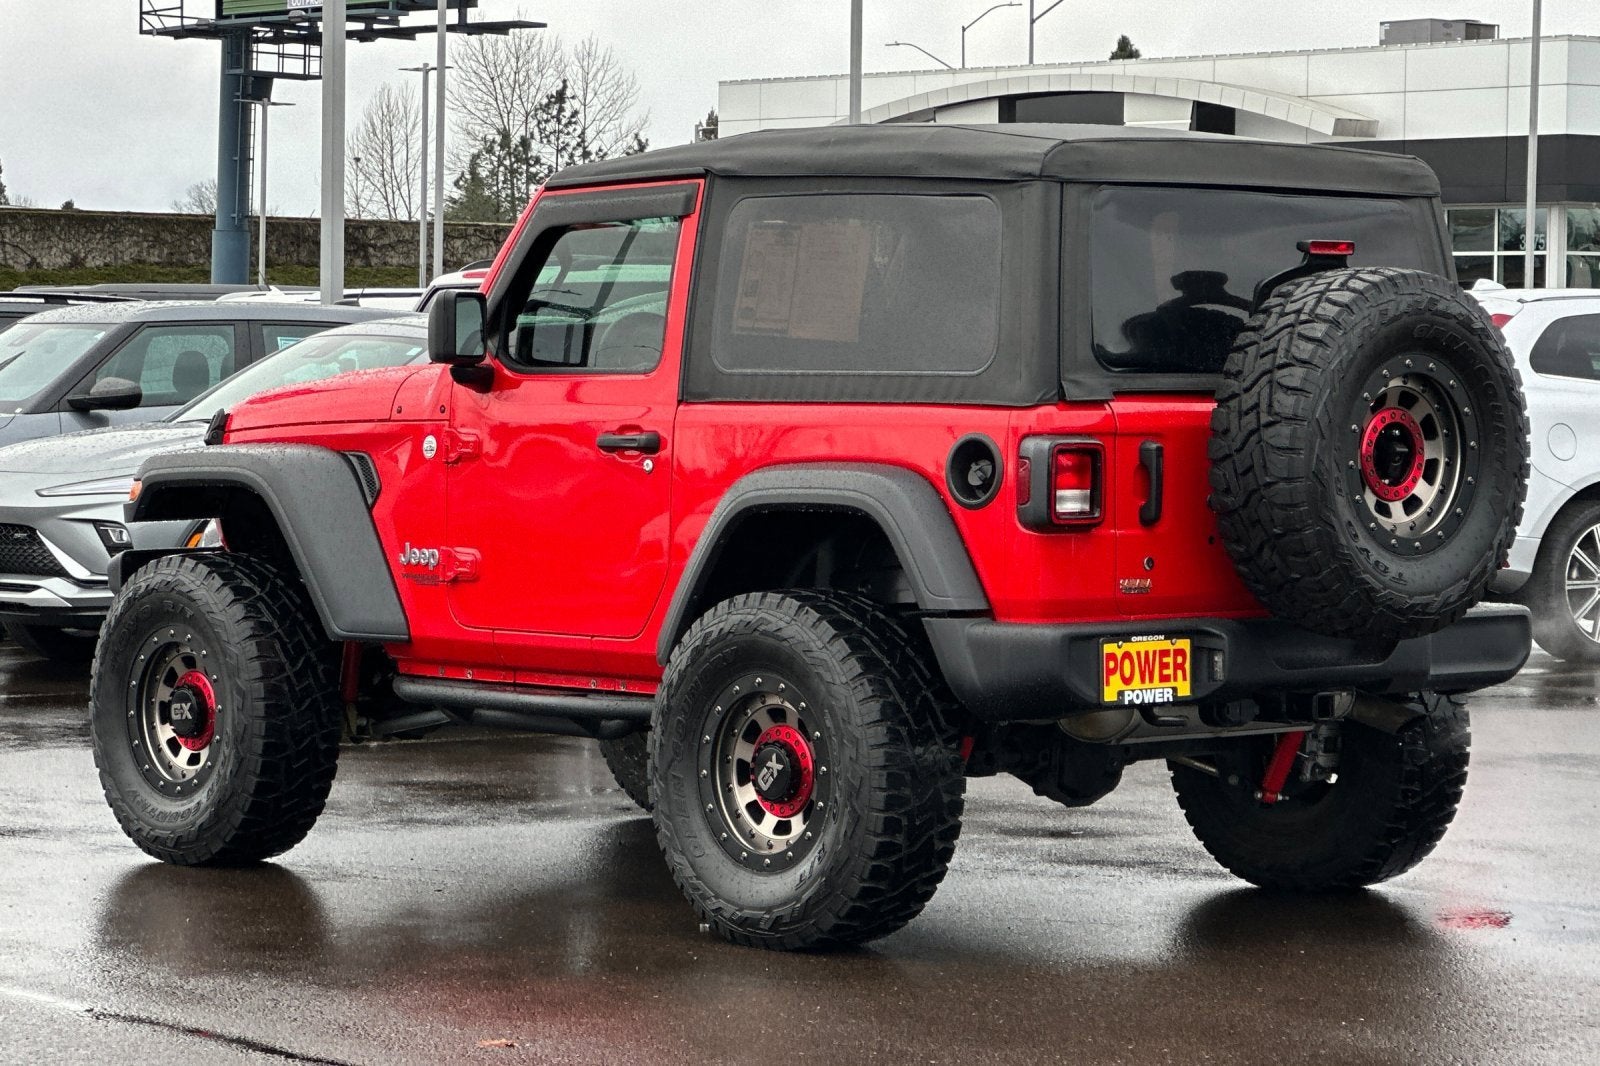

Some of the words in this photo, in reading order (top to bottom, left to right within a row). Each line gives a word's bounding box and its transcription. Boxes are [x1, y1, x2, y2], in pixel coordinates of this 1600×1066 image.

[1520, 233, 1545, 250] 375
[400, 542, 439, 571] Jeep
[1105, 648, 1188, 687] POWER
[1124, 688, 1173, 705] POWER
